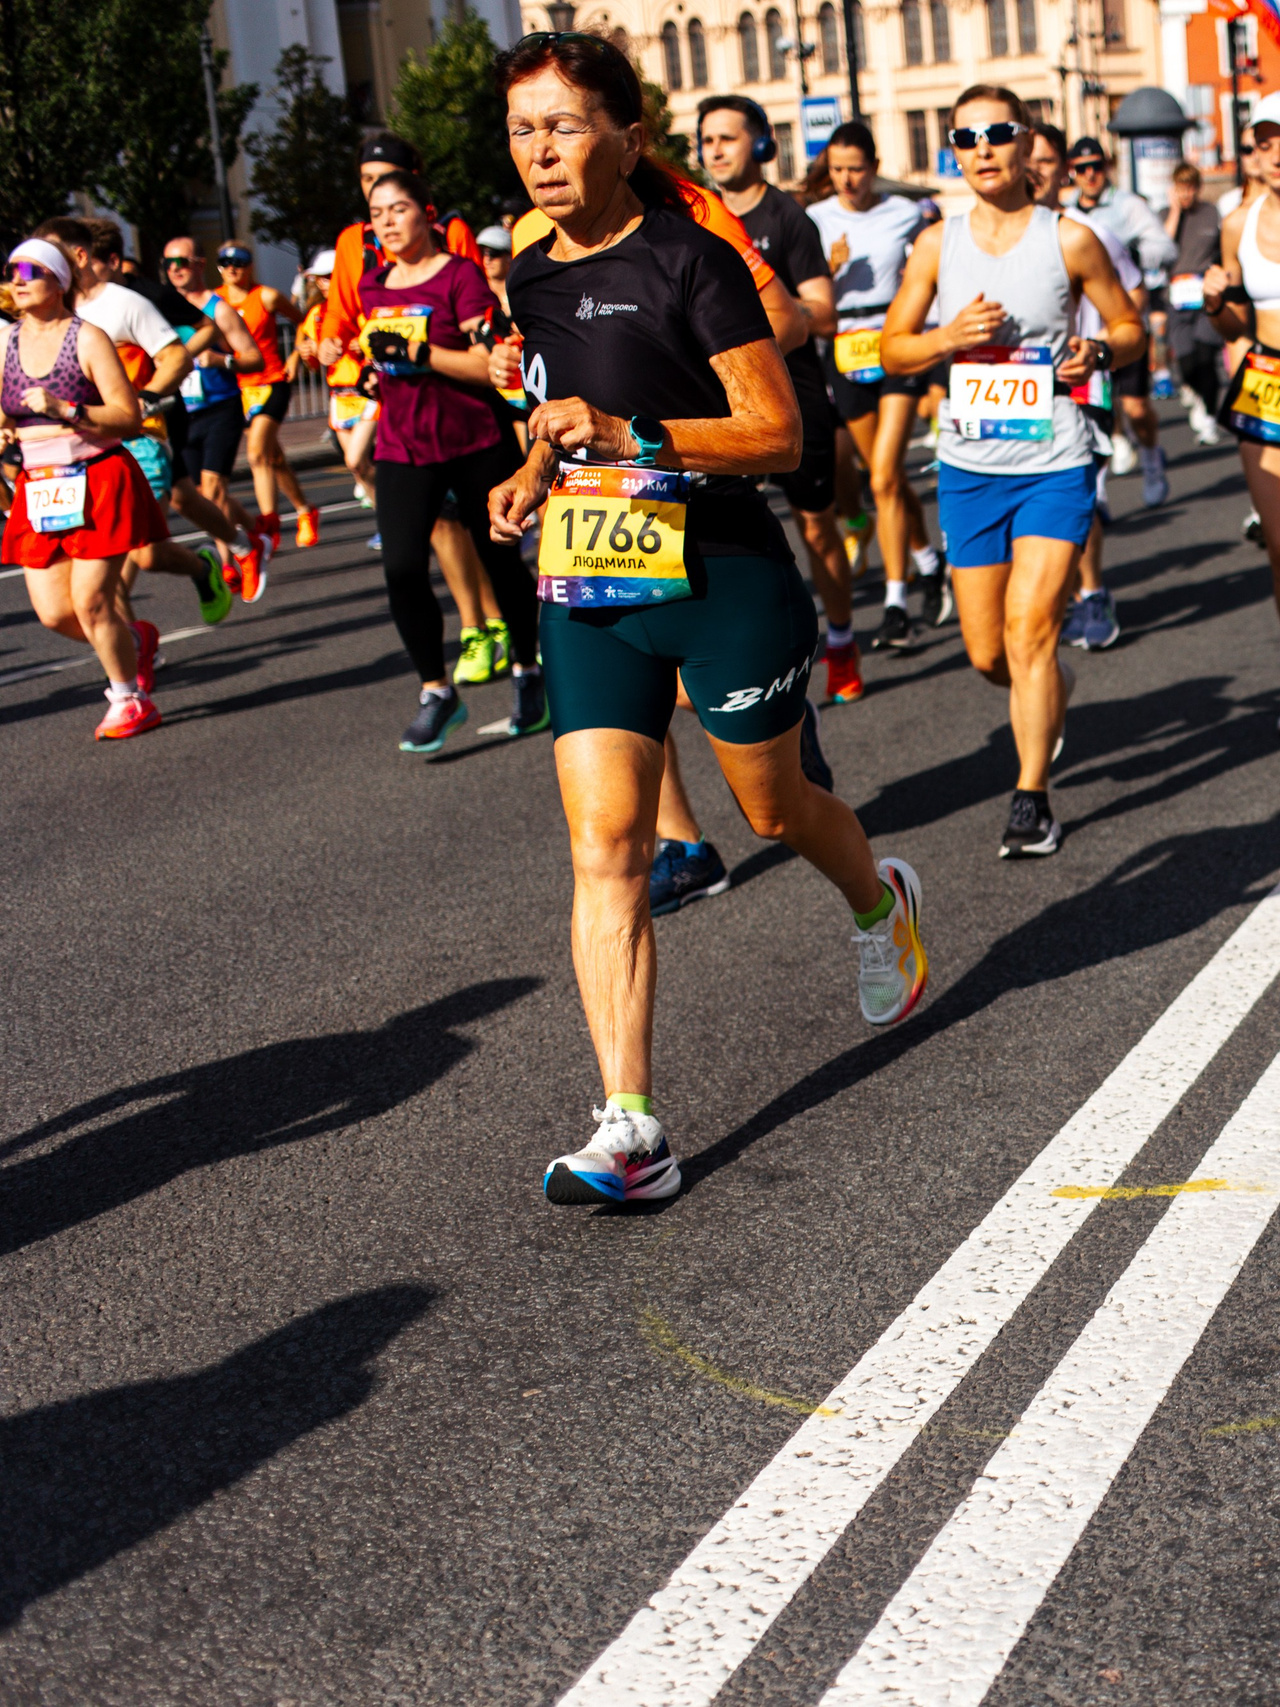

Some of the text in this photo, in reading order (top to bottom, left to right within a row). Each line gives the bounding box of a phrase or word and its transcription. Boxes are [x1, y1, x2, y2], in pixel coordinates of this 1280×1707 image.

[601, 303, 638, 311] NOVGOROD
[966, 379, 1038, 406] 7470
[565, 478, 602, 487] МАРАФОН
[621, 478, 643, 491] 21,1
[560, 508, 662, 554] 1766
[573, 556, 647, 570] ЛЮДМИЛА
[551, 579, 569, 603] E
